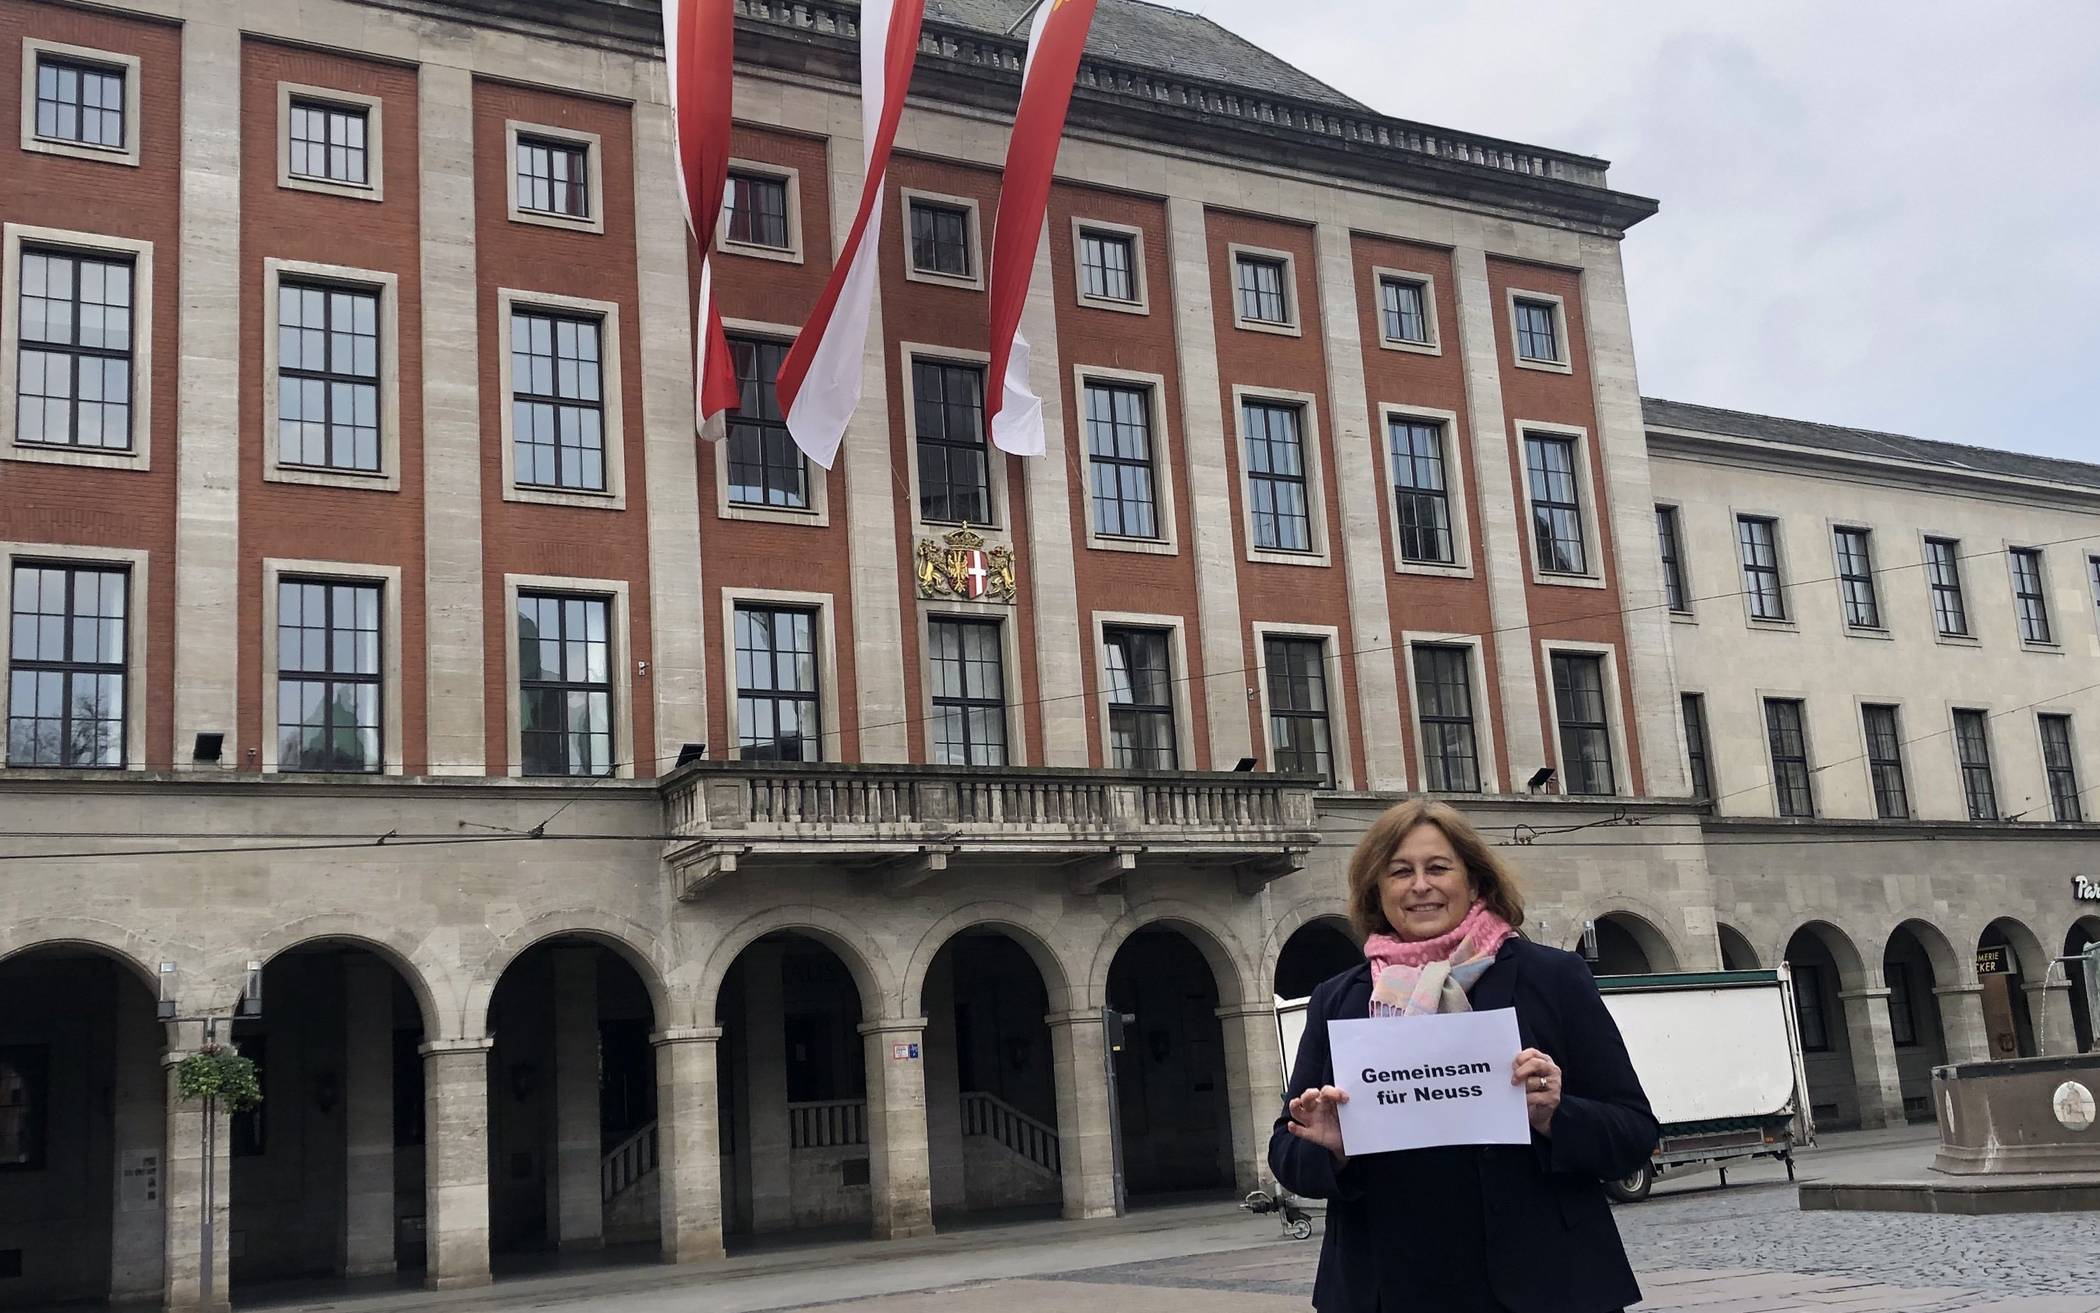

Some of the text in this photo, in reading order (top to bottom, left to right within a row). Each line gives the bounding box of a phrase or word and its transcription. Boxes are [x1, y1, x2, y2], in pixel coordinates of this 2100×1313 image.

[1361, 1062, 1491, 1083] Gemeinsam
[1377, 1085, 1483, 1105] für Neuss
